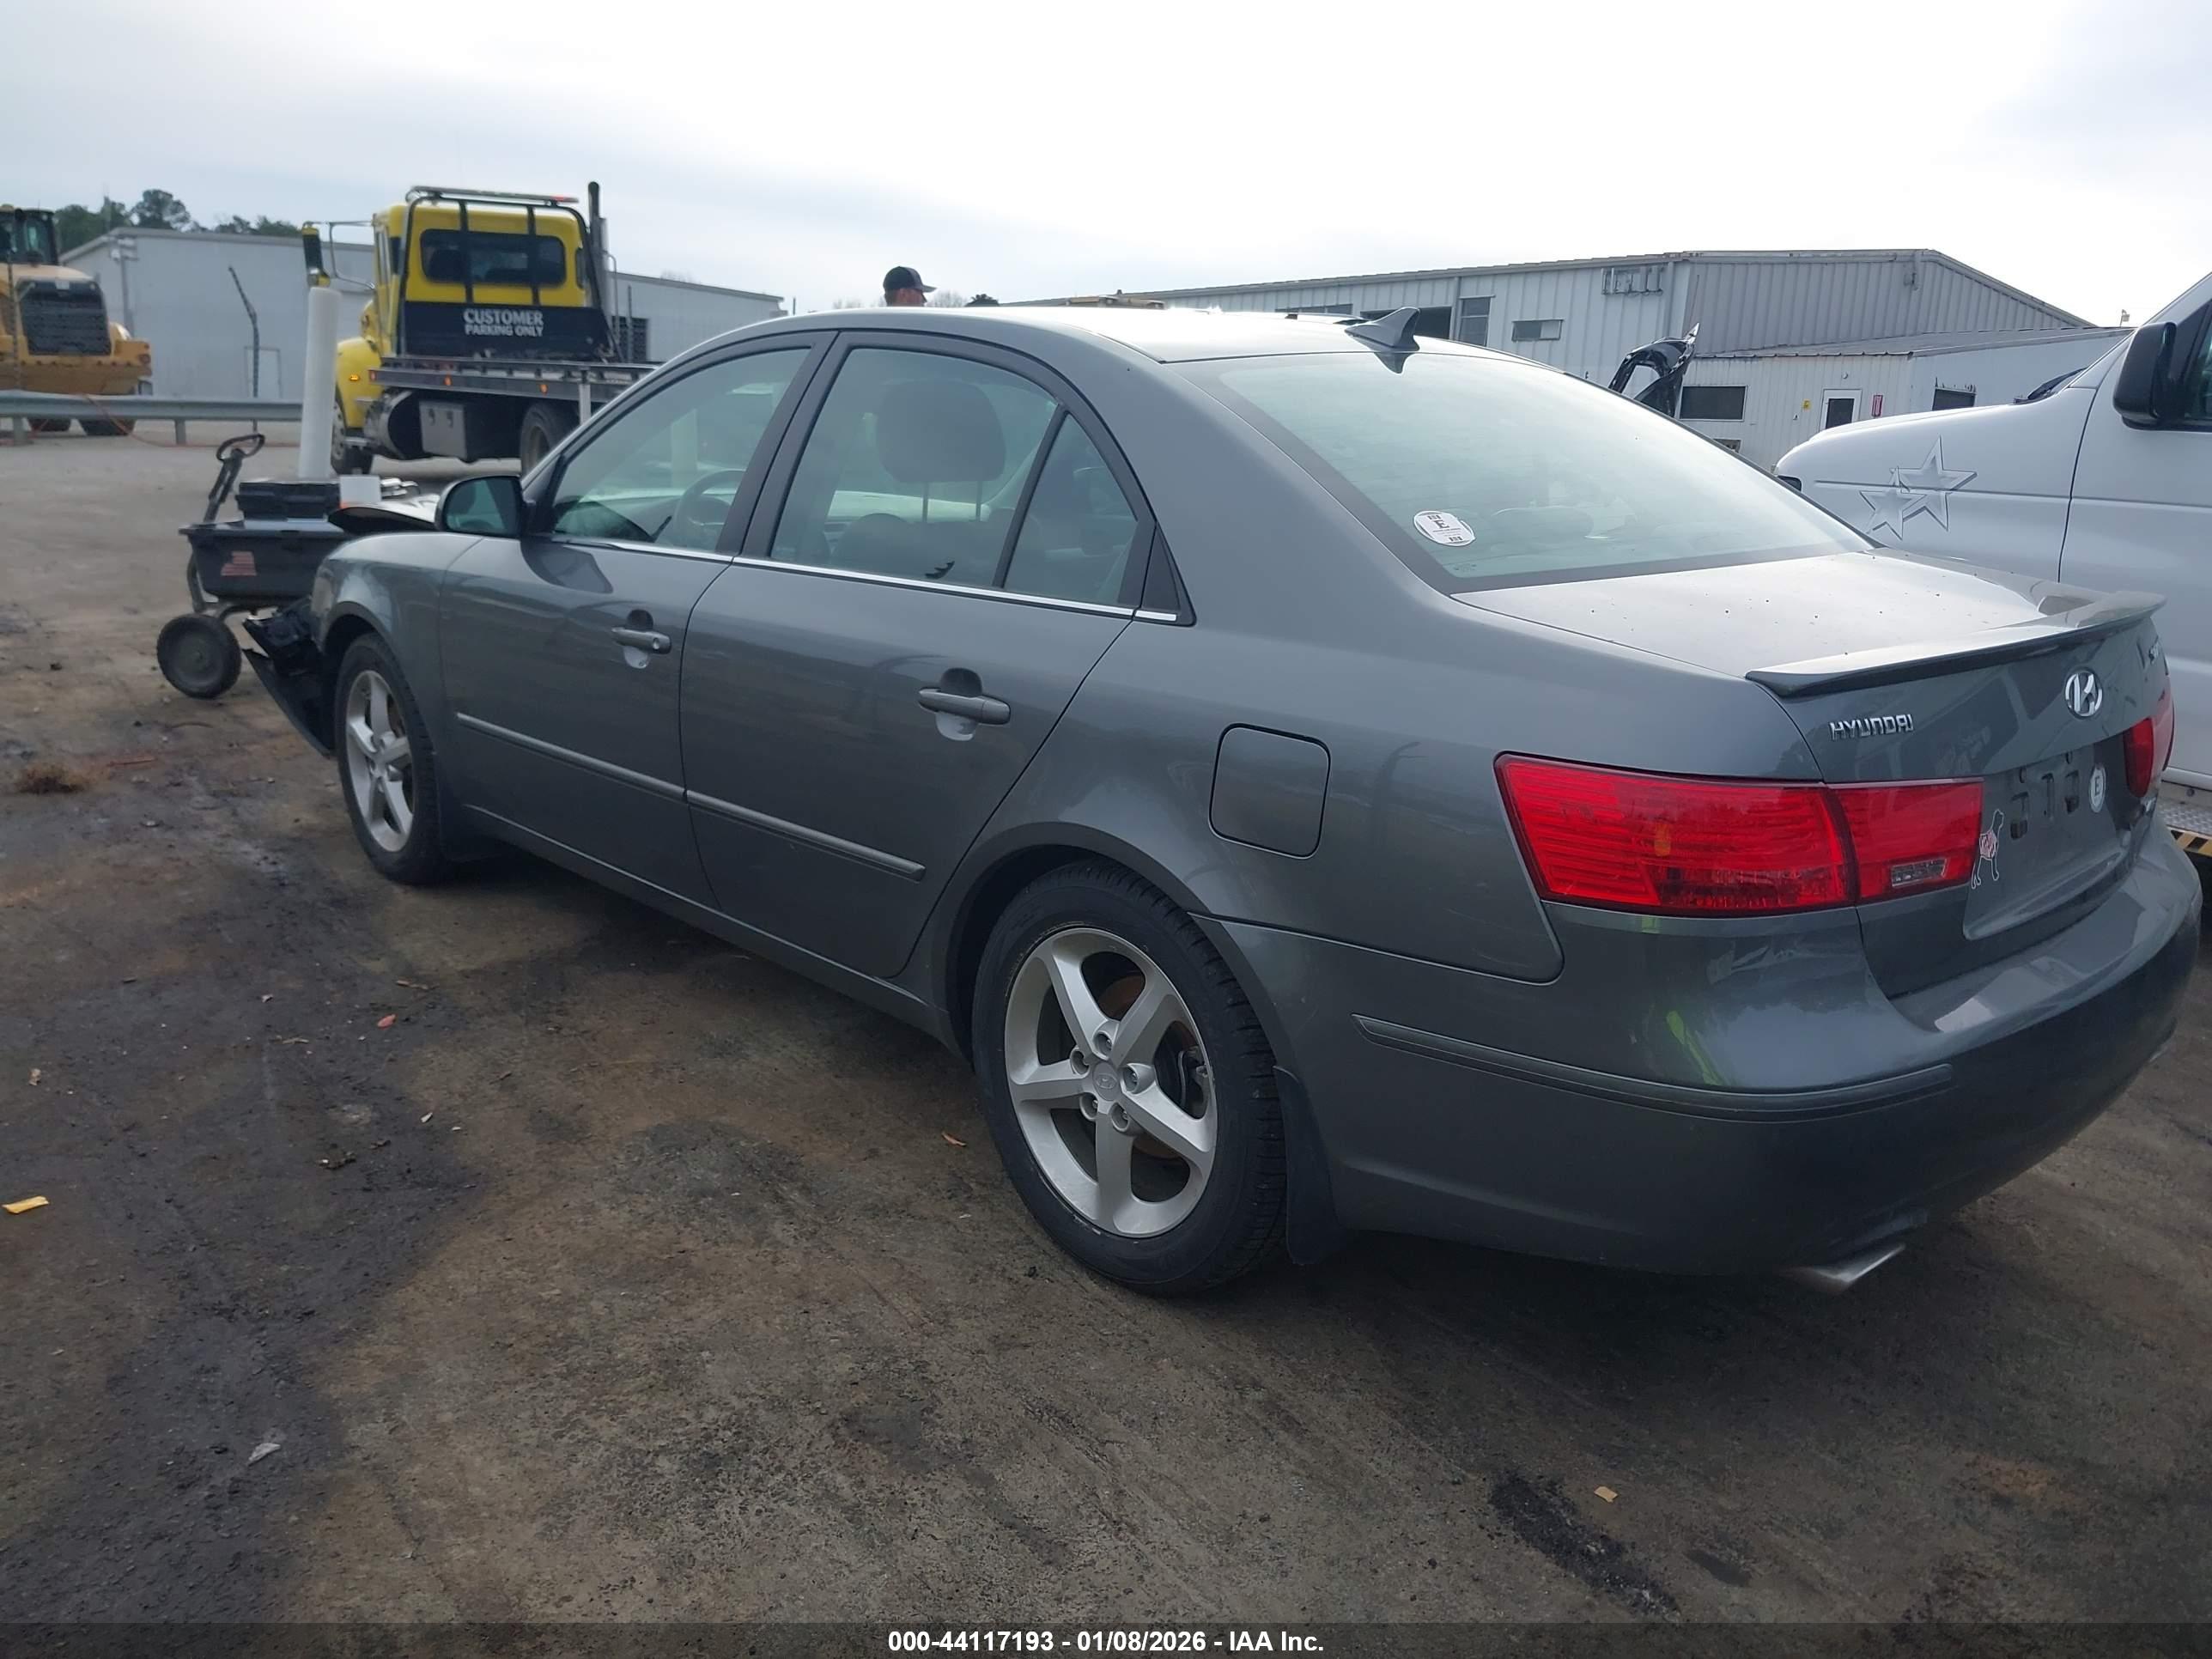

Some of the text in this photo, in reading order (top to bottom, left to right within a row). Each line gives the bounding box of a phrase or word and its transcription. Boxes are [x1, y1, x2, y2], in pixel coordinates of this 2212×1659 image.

[464, 308, 544, 325] CUSTOMER
[465, 324, 544, 337] PARKING ONLY
[1433, 520, 1450, 529] E
[1829, 714, 1915, 740] HYUNDAI
